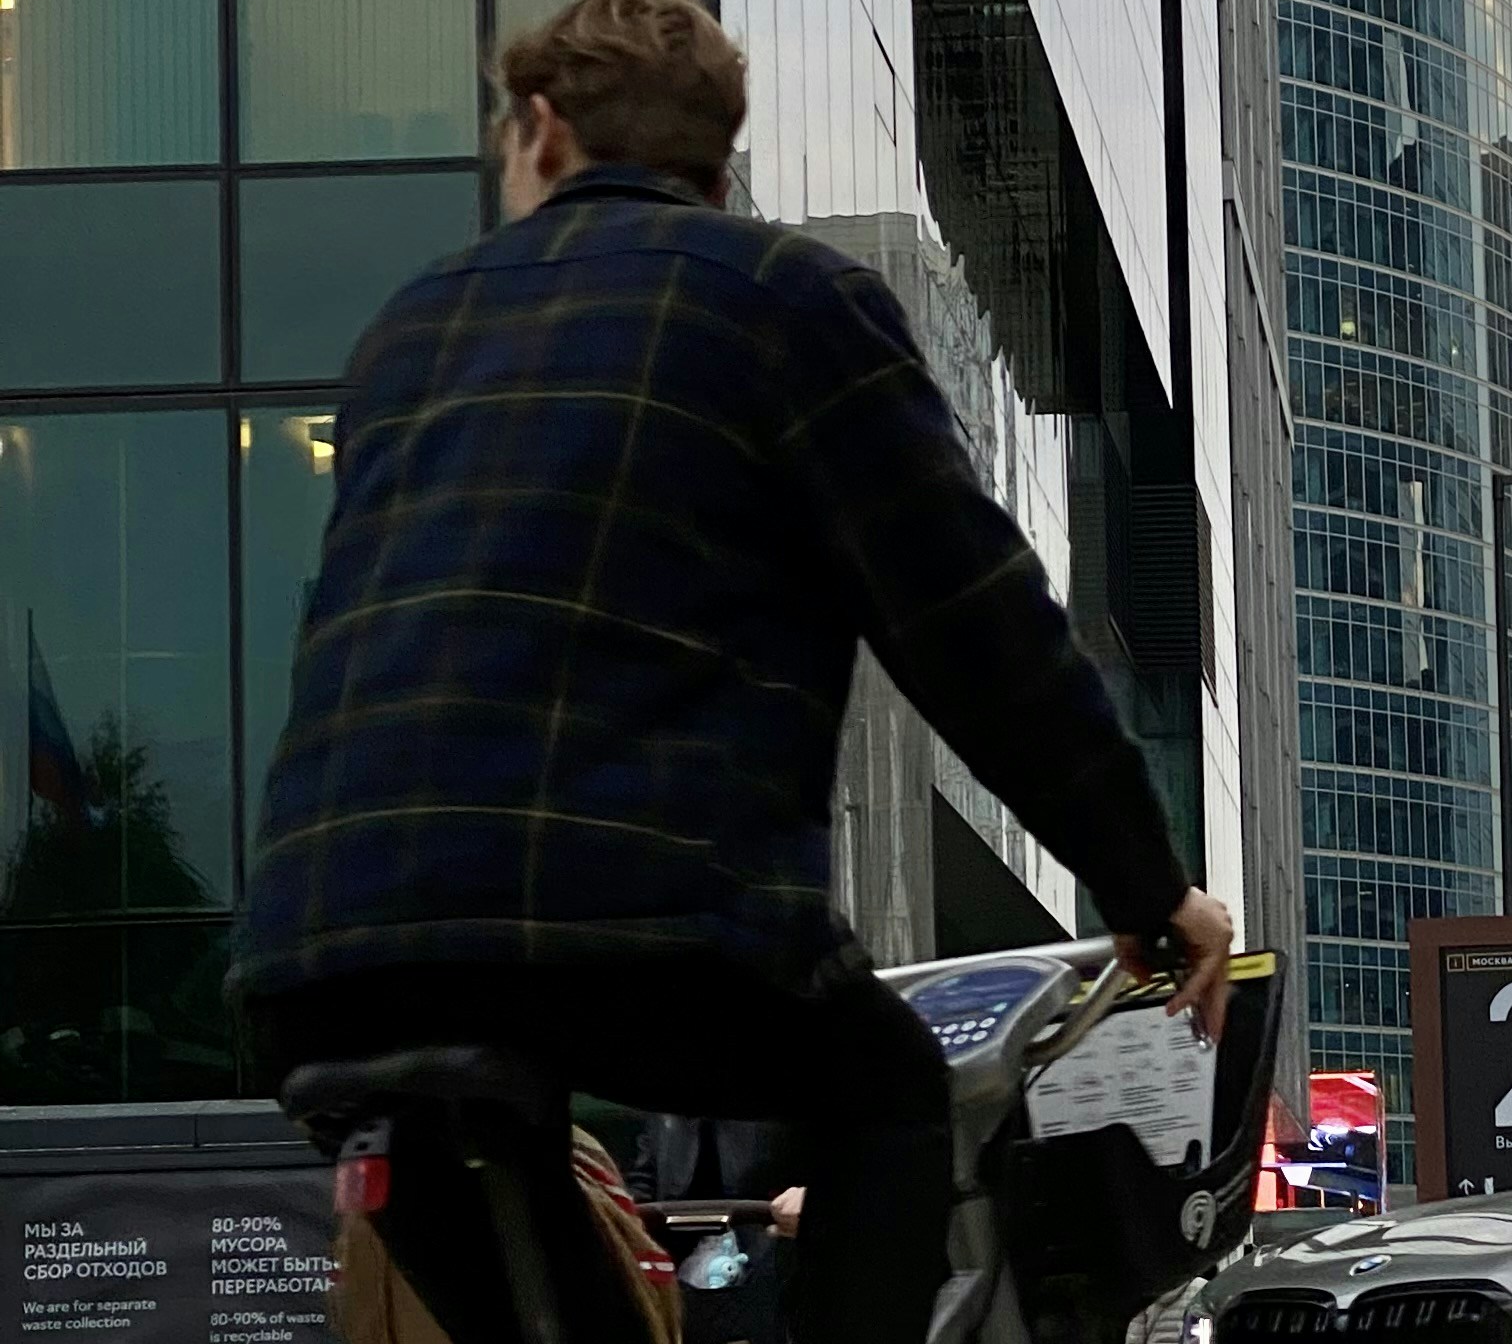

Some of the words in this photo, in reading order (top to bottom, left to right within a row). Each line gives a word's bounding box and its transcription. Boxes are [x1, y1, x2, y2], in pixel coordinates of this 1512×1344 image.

[25, 1223, 56, 1238] МЫ
[60, 1222, 83, 1237] ЗА
[212, 1216, 281, 1233] 80-90%
[24, 1236, 147, 1260] РАЗДЕЛЬНЫЙ
[212, 1237, 287, 1254] МУСОРА
[23, 1262, 73, 1280] СБОР
[75, 1260, 167, 1280] ОТХОДОВ
[212, 1257, 279, 1274] МОЖЕТ
[283, 1257, 332, 1272] БЫТЬ
[23, 1302, 45, 1314] We
[46, 1302, 69, 1313] are
[73, 1300, 94, 1312] for
[97, 1298, 157, 1315] separate
[22, 1319, 61, 1331] waste
[65, 1316, 130, 1330] collection
[211, 1312, 265, 1326] 80-90%
[269, 1312, 284, 1324] of
[286, 1313, 326, 1324] waste
[224, 1328, 293, 1344] recyclable
